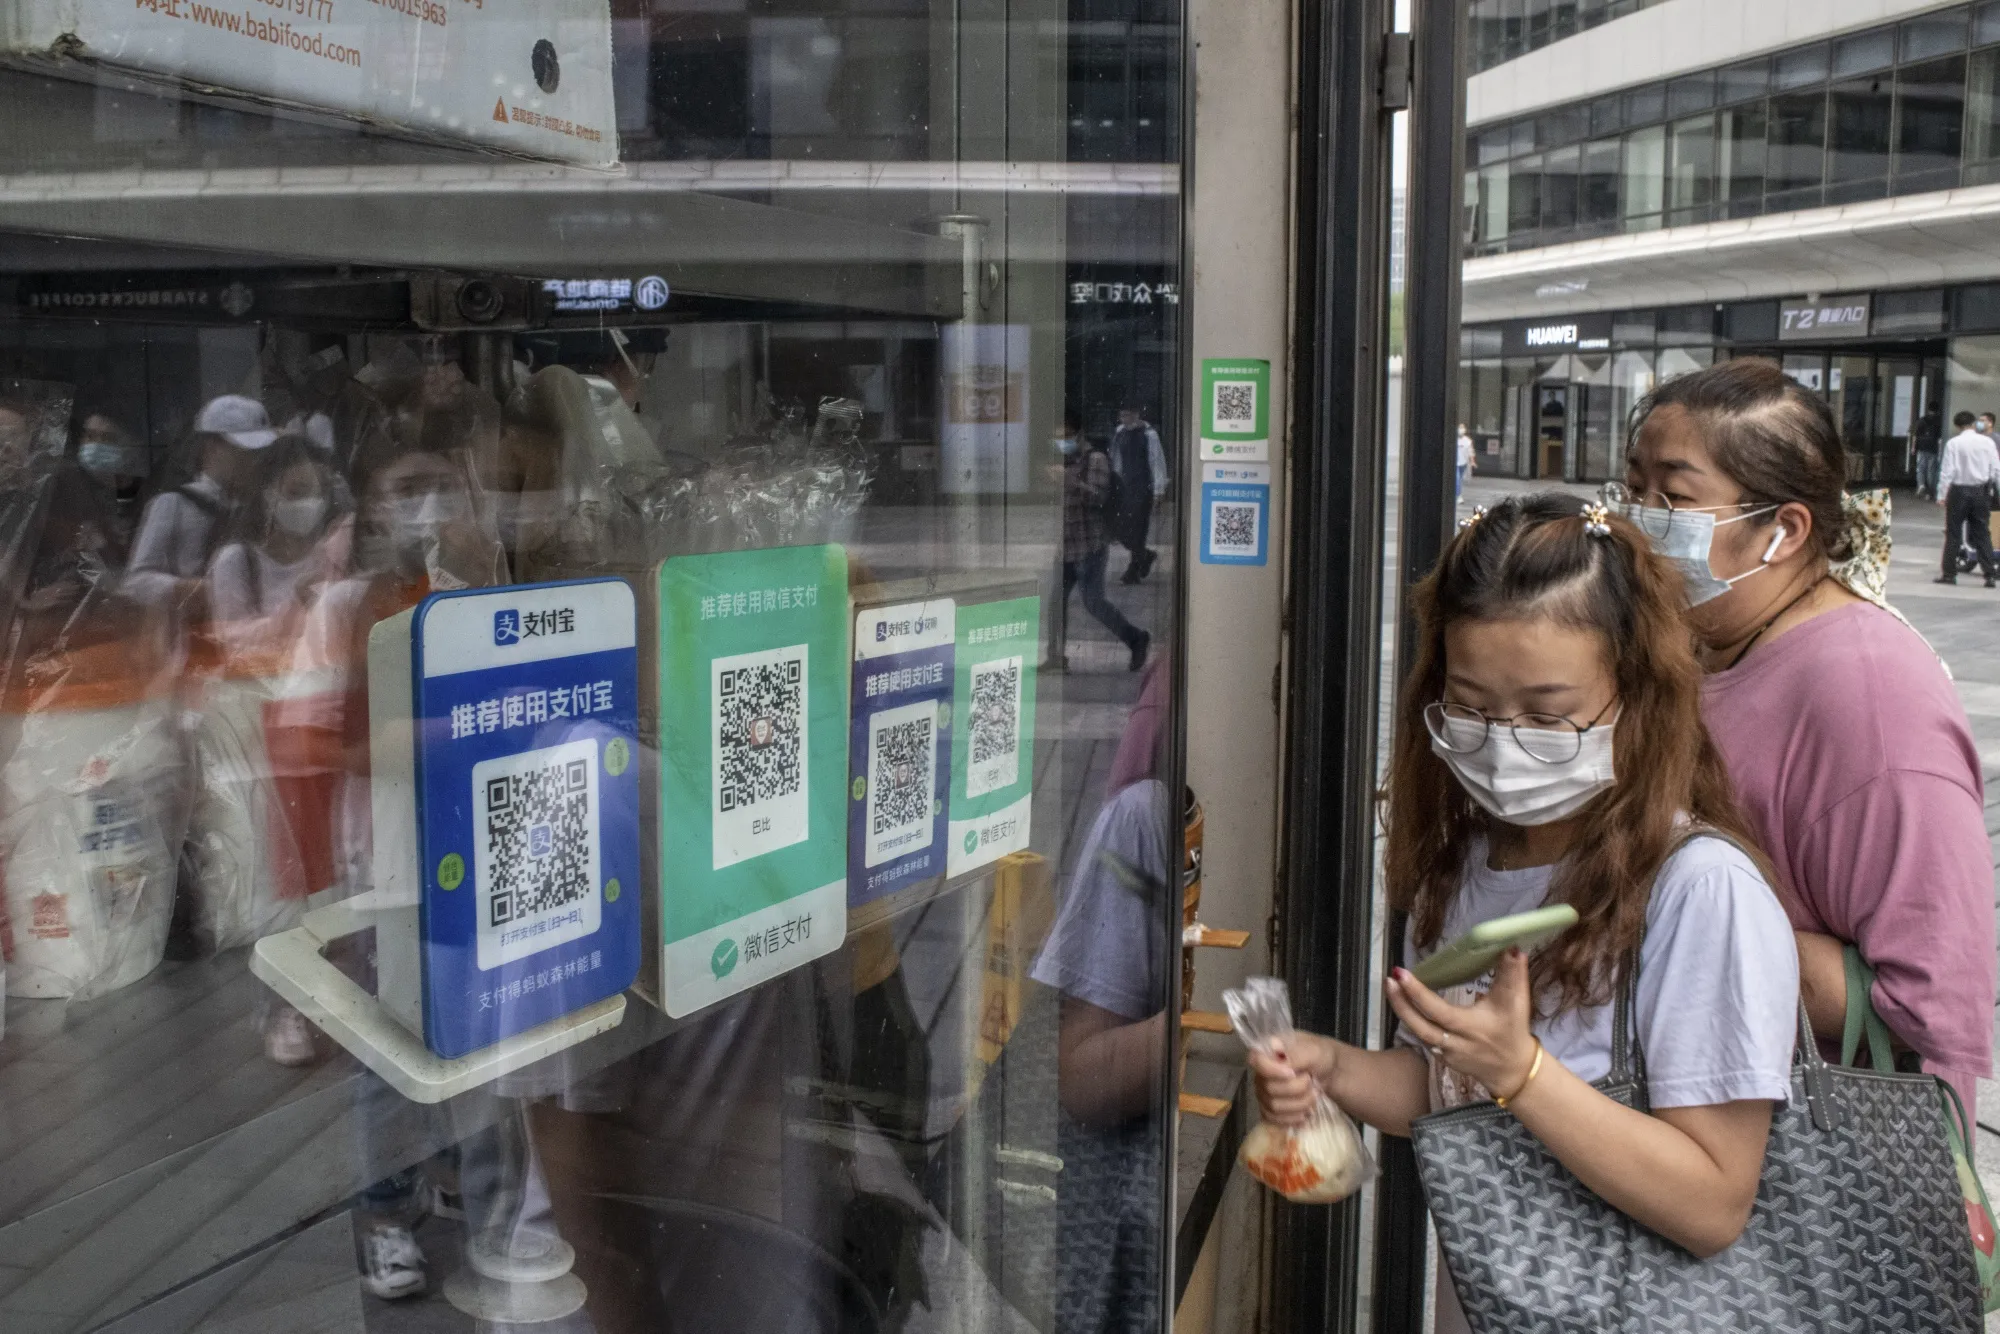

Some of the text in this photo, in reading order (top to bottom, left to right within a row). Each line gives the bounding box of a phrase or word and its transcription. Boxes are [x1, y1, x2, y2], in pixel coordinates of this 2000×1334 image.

[1527, 324, 1578, 345] HUAWEI
[701, 584, 818, 620] 推荐使用微信支付
[523, 608, 574, 638] 支付宝
[866, 662, 943, 698] 推荐使用支付宝
[451, 680, 613, 739] 推荐使用支付宝
[752, 816, 771, 835] 巴比
[980, 817, 1017, 846] 微信支付
[744, 912, 812, 963] 微信支付
[478, 949, 602, 1012] 支付得蚂蚁森林能量
